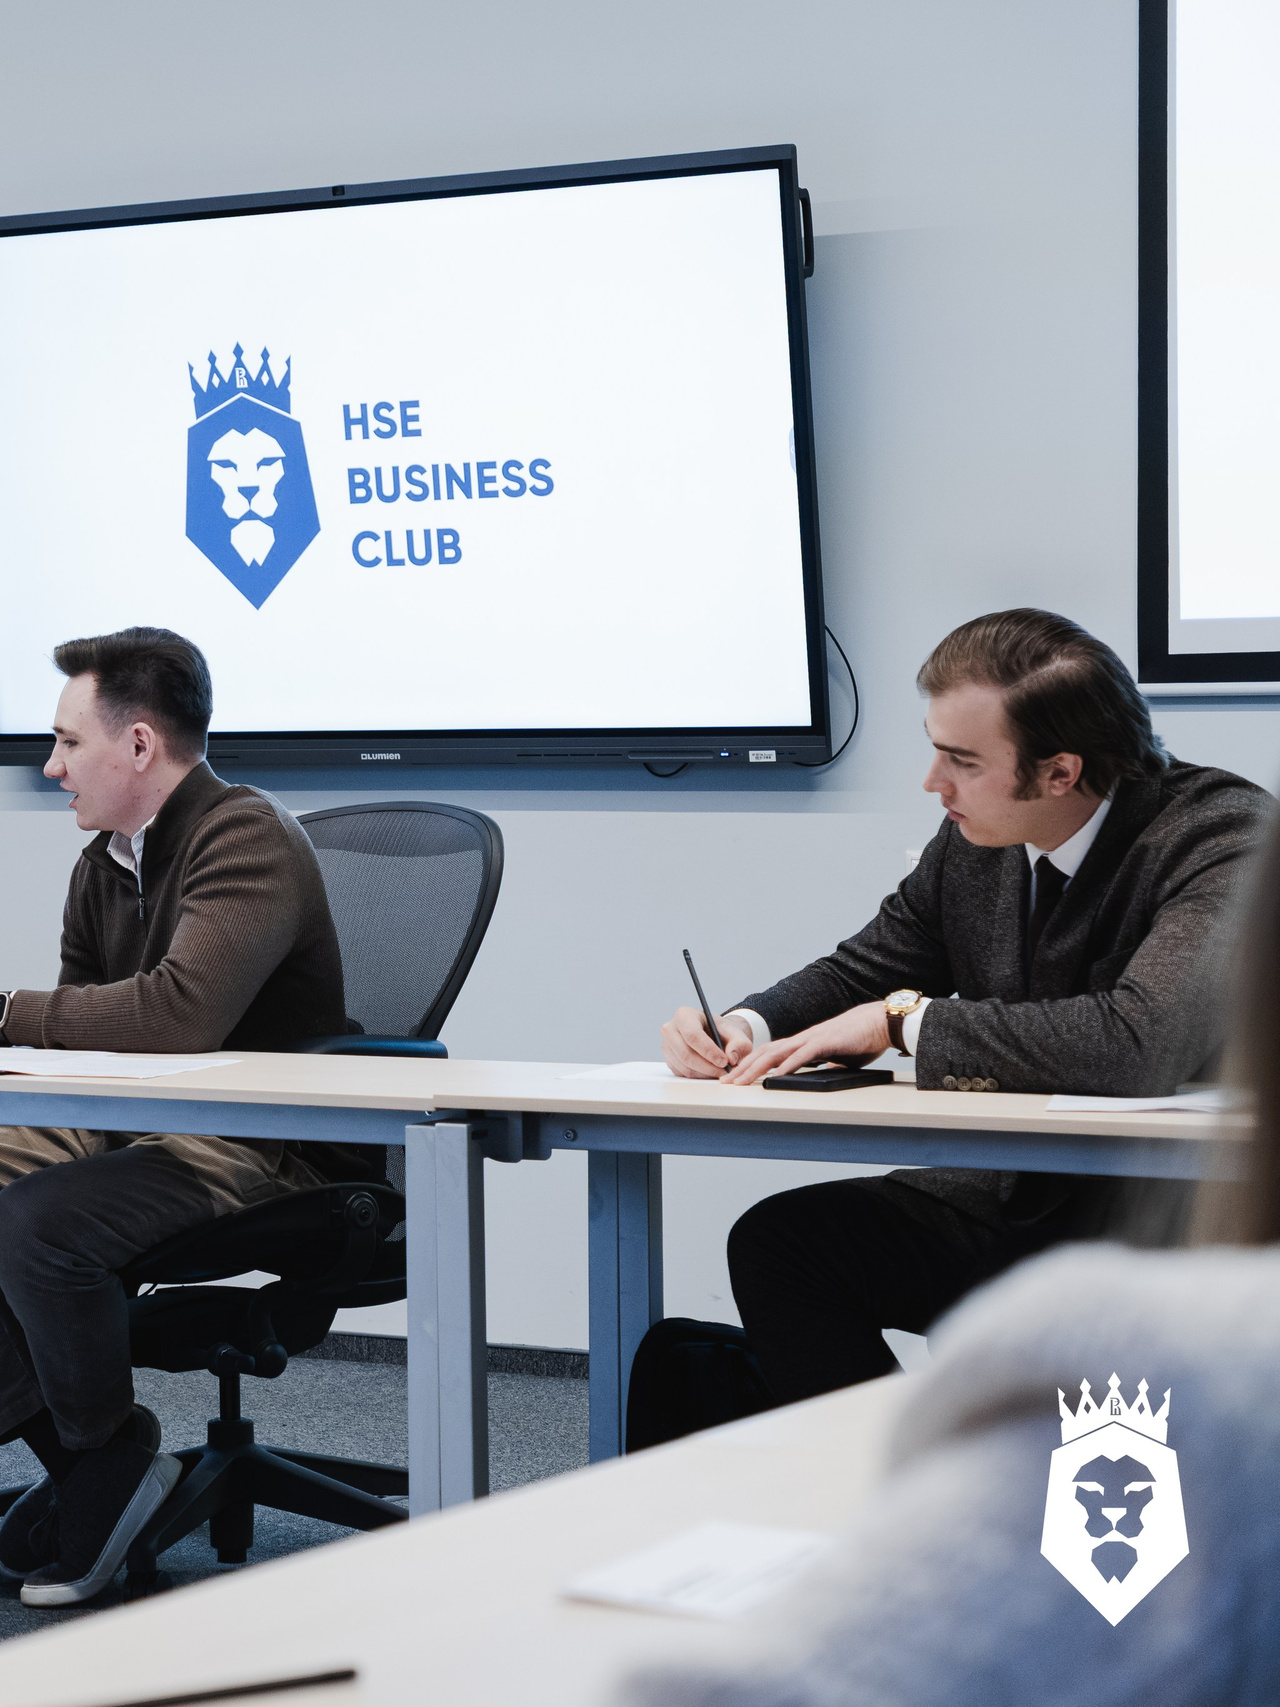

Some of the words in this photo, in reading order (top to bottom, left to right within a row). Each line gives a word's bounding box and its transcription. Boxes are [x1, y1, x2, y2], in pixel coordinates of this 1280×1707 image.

[341, 399, 423, 442] HSE
[346, 457, 555, 505] BUSINESS
[350, 527, 464, 569] CLUB
